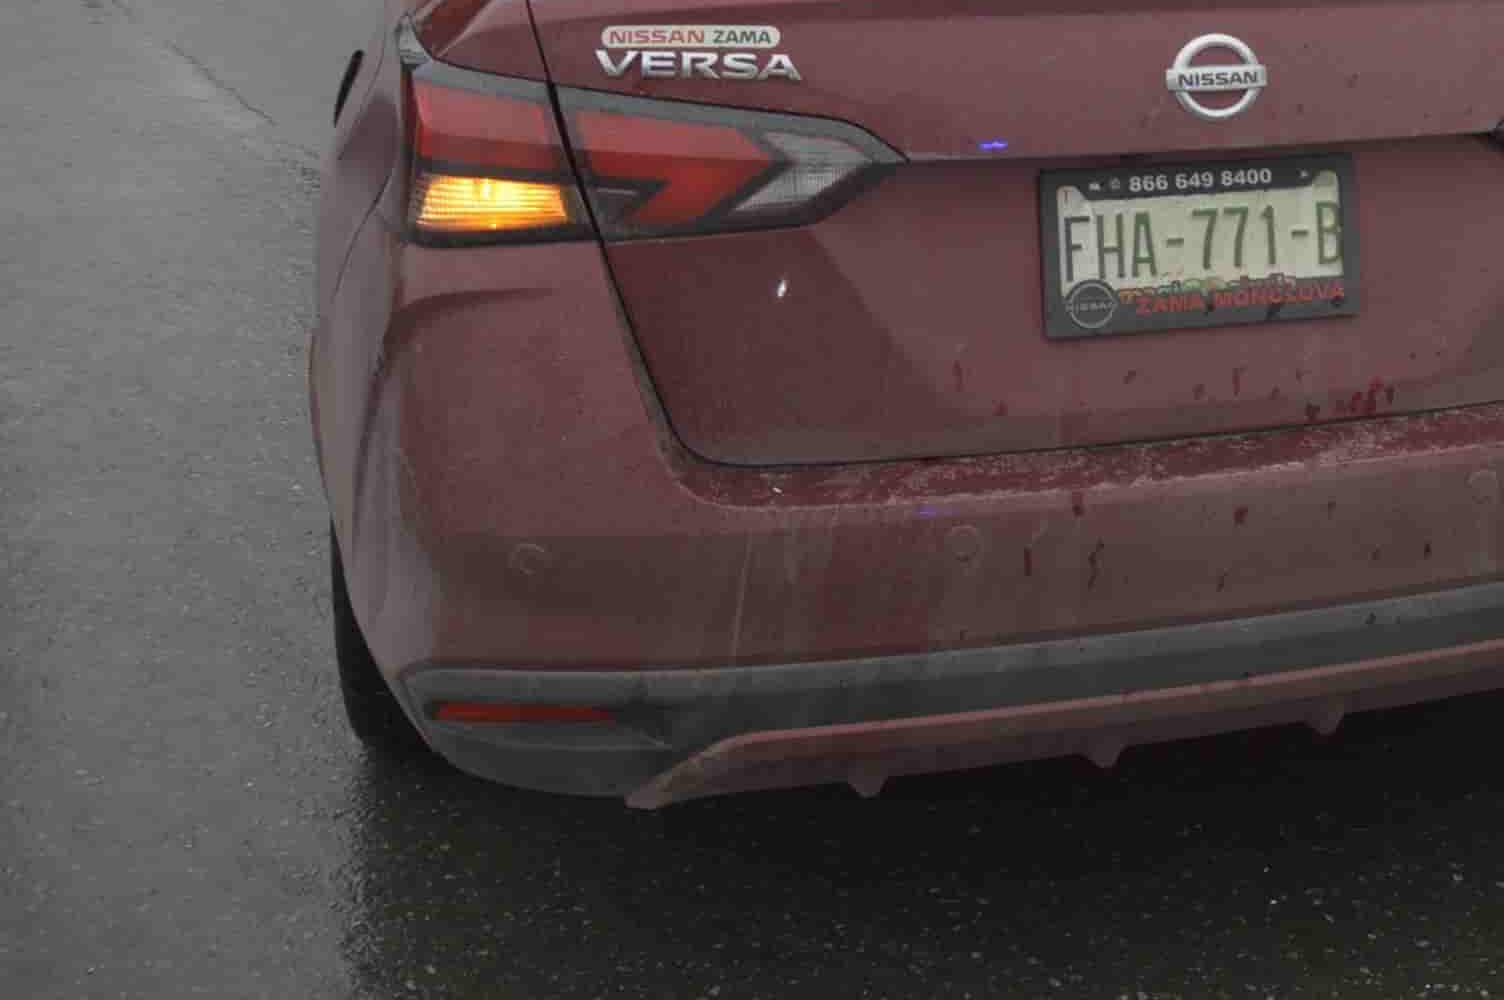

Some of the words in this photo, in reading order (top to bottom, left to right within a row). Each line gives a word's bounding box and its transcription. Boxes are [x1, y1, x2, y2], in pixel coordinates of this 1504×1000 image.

[609, 29, 705, 45] NISSAN
[712, 29, 772, 45] ZAMA
[595, 49, 803, 81] VERSA
[1178, 71, 1258, 88] NISSAN
[1128, 174, 1169, 193] 866
[1175, 172, 1214, 190] 649
[1220, 167, 1272, 187] 8400
[1063, 200, 1344, 283] FHA-771-B
